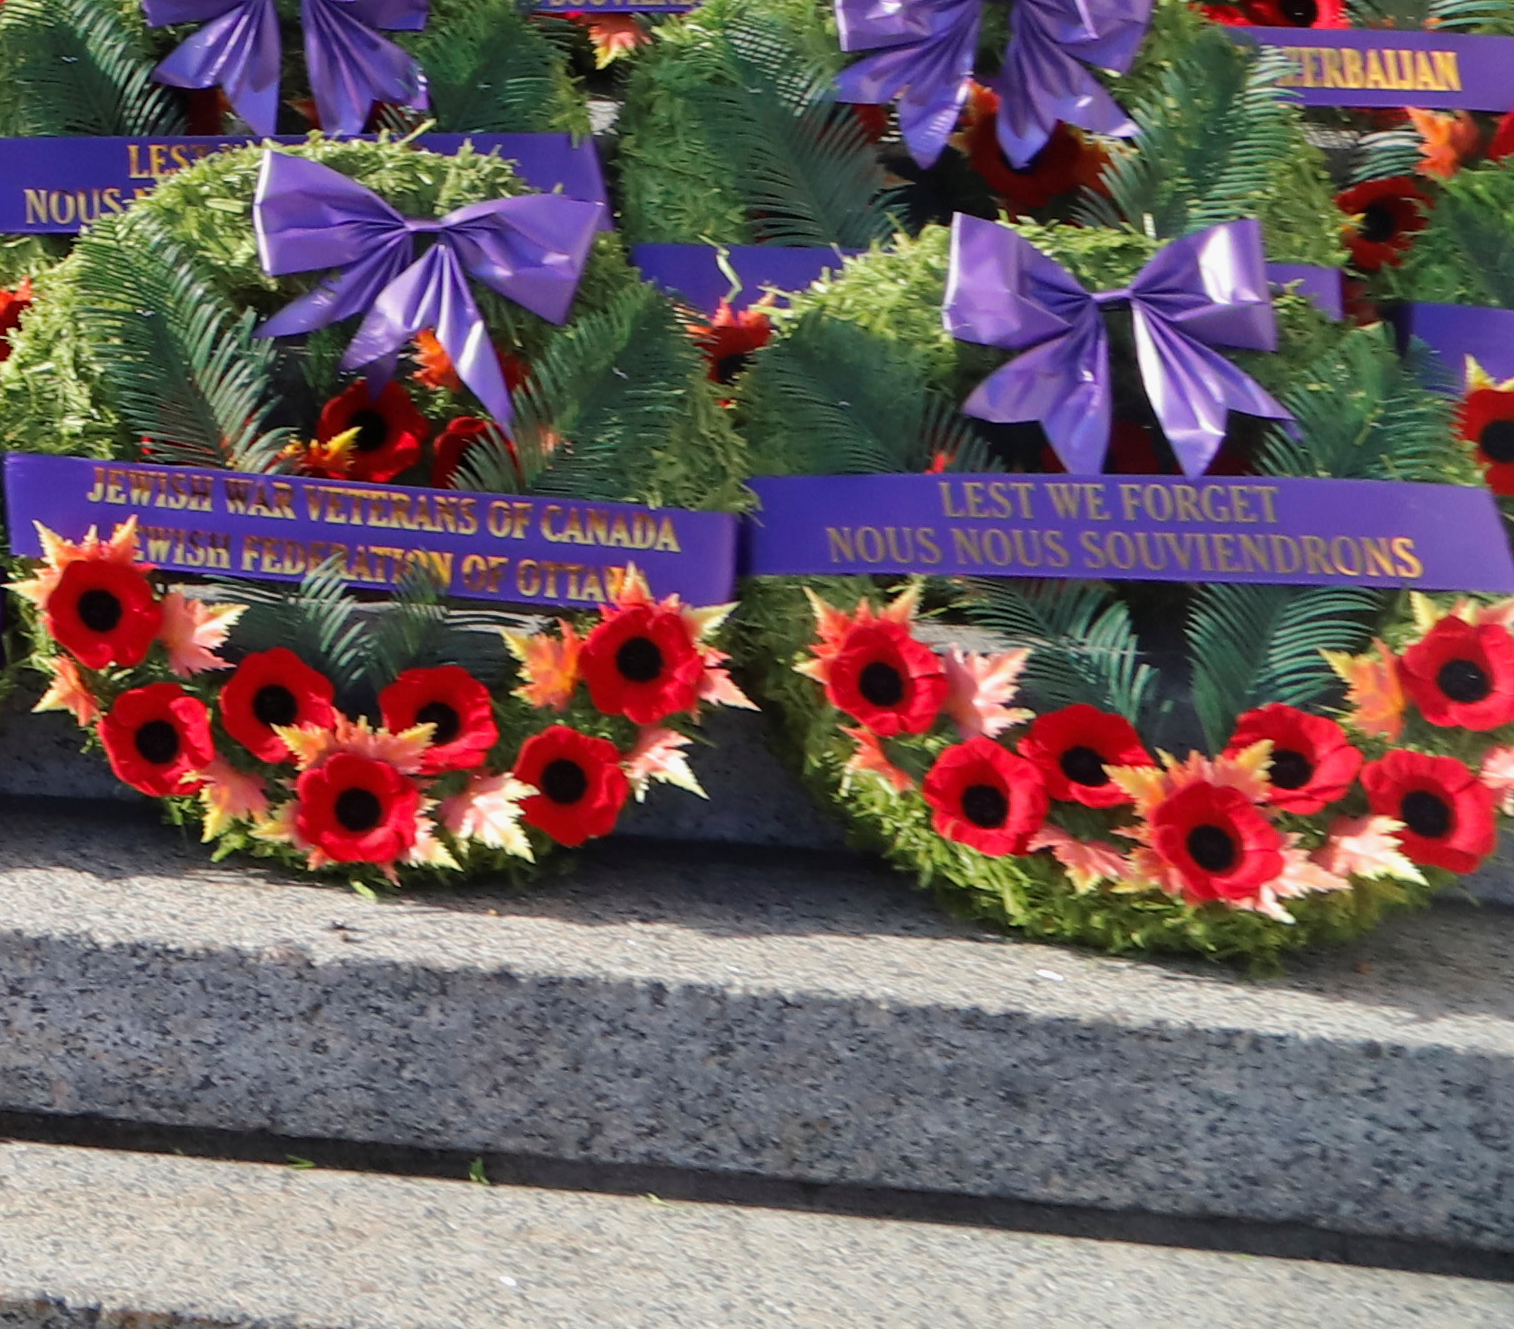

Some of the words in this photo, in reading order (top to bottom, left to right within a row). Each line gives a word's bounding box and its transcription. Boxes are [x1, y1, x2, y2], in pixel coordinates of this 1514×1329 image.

[87, 467, 215, 513] JEWISH
[224, 477, 297, 521] WAR
[303, 483, 480, 536] VETERANS
[486, 499, 535, 540] OF
[539, 504, 682, 553] CANADA
[938, 480, 1037, 520] LEST
[1044, 482, 1112, 521] WE
[1119, 483, 1280, 524] FORGET
[241, 534, 455, 590] FEDERATION
[461, 553, 510, 593] OF
[826, 525, 943, 564] NOUS
[950, 527, 1072, 570] NOUS
[1080, 530, 1424, 579] SOUVIENDRONS
